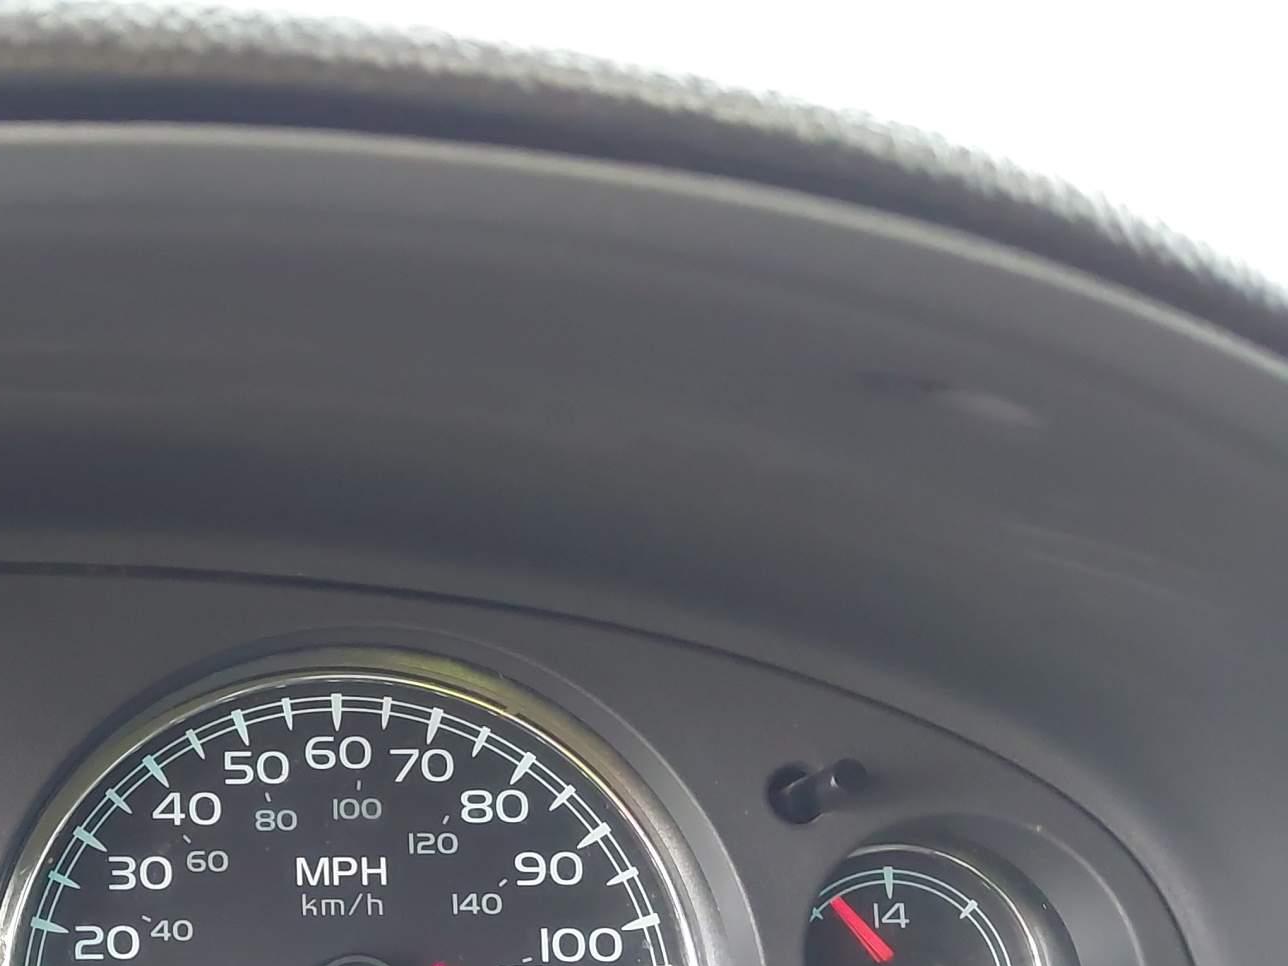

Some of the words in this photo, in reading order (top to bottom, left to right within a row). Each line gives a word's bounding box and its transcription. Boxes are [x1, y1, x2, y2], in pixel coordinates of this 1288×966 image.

[223, 752, 290, 785] 50
[304, 736, 372, 770] 60
[389, 748, 454, 783] 70
[152, 792, 222, 826] 40
[255, 809, 298, 832] 80
[332, 798, 382, 821] 100
[460, 789, 529, 824] 80
[408, 833, 459, 855] 120
[107, 855, 173, 891] 30
[186, 850, 229, 873] 60
[295, 857, 387, 886] MPH
[514, 851, 583, 887] 90
[301, 893, 384, 917] km/h
[452, 893, 503, 915] 140
[873, 904, 910, 930] 14
[74, 925, 140, 960] 20
[150, 920, 194, 943] 40
[540, 927, 623, 963] 100
